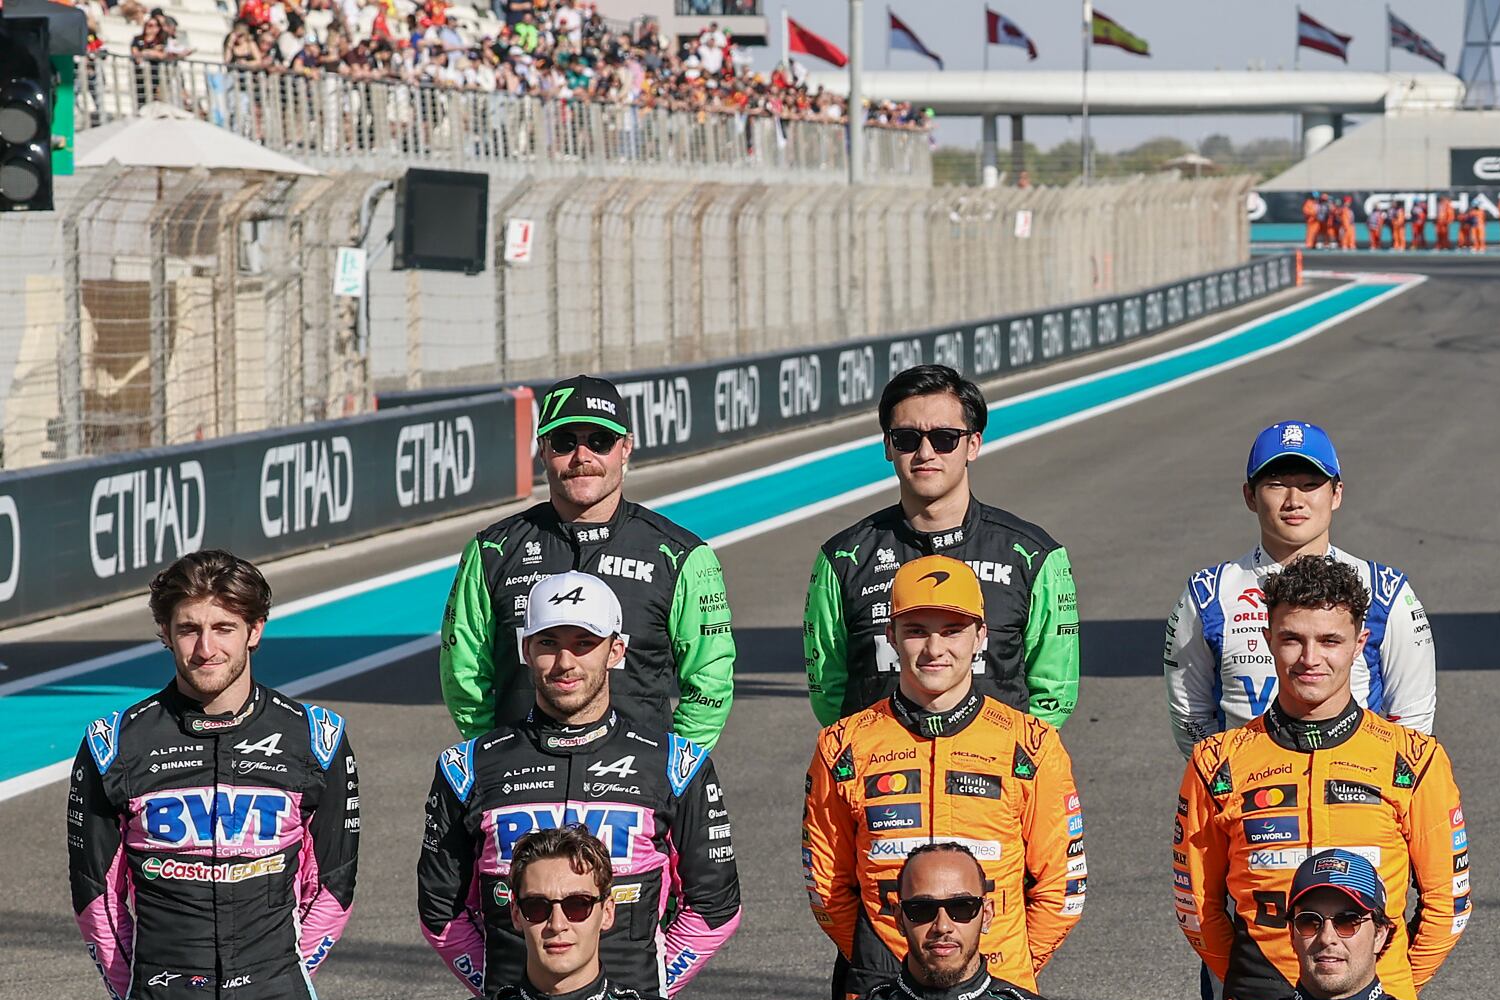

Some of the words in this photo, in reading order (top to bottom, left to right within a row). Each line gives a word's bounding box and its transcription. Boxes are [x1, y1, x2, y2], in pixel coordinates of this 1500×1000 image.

[779, 354, 821, 418] ETIHAD
[586, 397, 616, 416] KICK
[715, 365, 760, 433] ETIHAD
[615, 376, 692, 449] TIHAD
[396, 416, 475, 507] ETIHAD
[260, 436, 353, 537] ETIHAD
[89, 460, 206, 577] ETIHAD
[598, 554, 654, 583] KICK
[1232, 655, 1272, 664] TUDOR
[150, 746, 203, 756] ALPINE
[869, 748, 916, 765] Android
[162, 760, 203, 770] BINANCE
[504, 765, 556, 777] ALPINE
[1247, 763, 1292, 783] Android
[513, 781, 554, 791] BINANCE
[959, 786, 986, 794] CISCO
[146, 792, 286, 843] BWT
[873, 820, 883, 828] DP
[871, 840, 907, 857] DELL
[1251, 852, 1287, 864] DELL
[162, 860, 227, 881] Castrol
[222, 975, 251, 988] JACK
